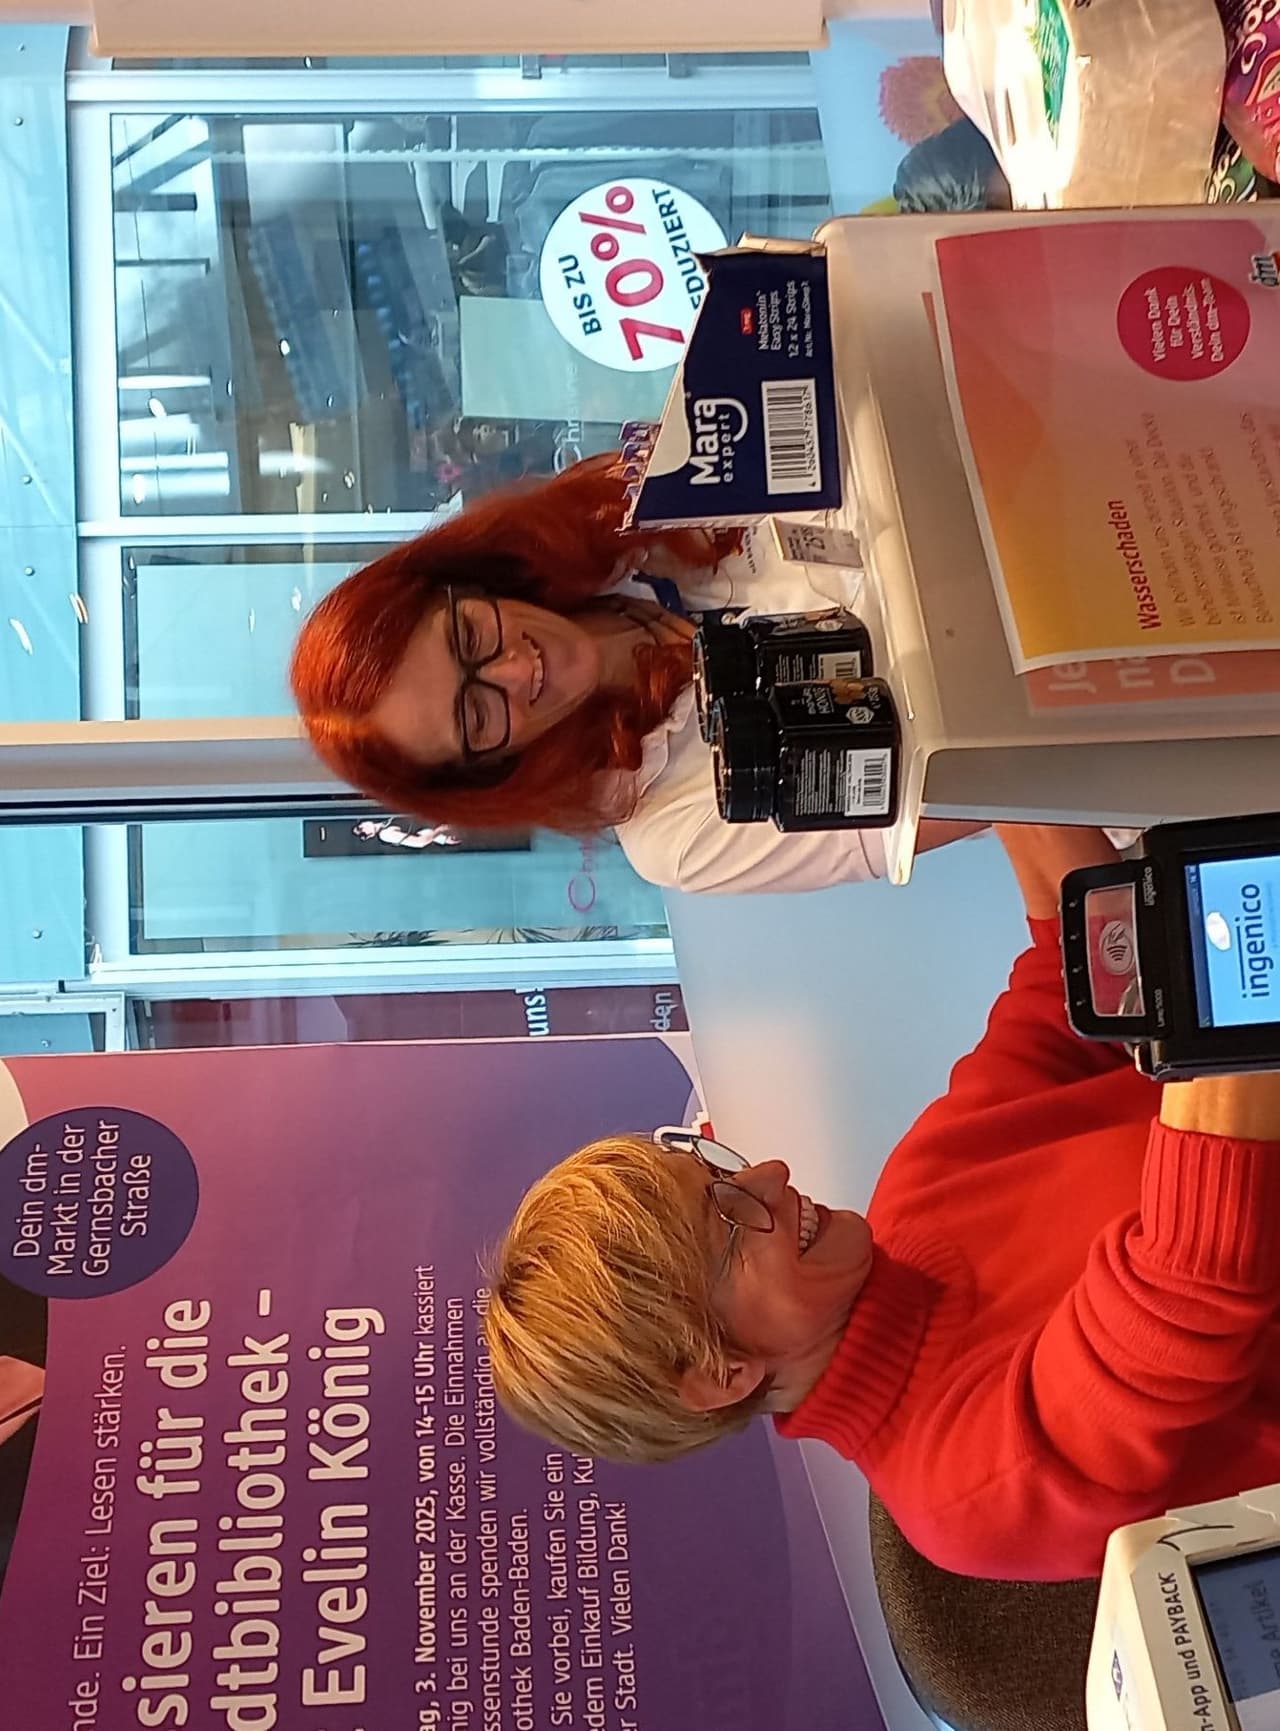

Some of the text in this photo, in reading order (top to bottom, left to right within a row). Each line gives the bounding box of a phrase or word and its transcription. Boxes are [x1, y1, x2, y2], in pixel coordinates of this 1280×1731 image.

[578, 185, 686, 361] 70%
[651, 188, 704, 310] EDUZIERT
[1249, 254, 1280, 287] dm
[558, 254, 602, 336] BIS ZU
[1144, 286, 1166, 362] Vielen Dank
[1164, 295, 1183, 347] für Dein
[1207, 331, 1224, 362] Dein
[689, 398, 748, 485] Mara
[718, 412, 735, 482] expert
[1107, 500, 1162, 630] Wasserschaden
[1234, 883, 1274, 999] ingenico
[12, 1143, 49, 1257] Dein dm-
[46, 1124, 85, 1275] Markt in der
[82, 1119, 120, 1276] Gernsbacher
[120, 1154, 152, 1237] Straße
[414, 1265, 434, 1335] kassiert
[414, 1341, 435, 1376] Uhr
[443, 1297, 465, 1406] Einnahmen
[93, 1345, 126, 1448] stärken.
[444, 1414, 465, 1447] Die
[85, 1458, 117, 1535] Lesen
[419, 1445, 436, 1481] von
[445, 1456, 467, 1520] Kasse.
[475, 1470, 497, 1501] wir
[122, 1299, 211, 1727] sieren für die
[210, 1333, 290, 1731] dtbibliothek
[302, 1307, 385, 1706] Evelin König
[415, 1489, 438, 1543] 2025,
[575, 1492, 601, 1579] Bildung,
[605, 1502, 629, 1561] Dank!
[77, 1546, 111, 1605] Ziel:
[446, 1529, 467, 1564] der
[476, 1509, 503, 1598] spenden
[508, 1508, 532, 1657] Baden-Baden.
[415, 1551, 437, 1663] November
[450, 1573, 467, 1599] an
[543, 1453, 573, 1725] Sie vorbei, kaufen Sie ein
[610, 1569, 634, 1635] Vielen
[1158, 1572, 1192, 1645] PAYBACK
[73, 1616, 105, 1660] Ein
[450, 1607, 468, 1647] uns
[578, 1586, 603, 1668] Einkauf
[415, 1672, 436, 1693] 3.
[446, 1656, 468, 1691] bei
[613, 1643, 638, 1710] Stadt.
[1177, 1649, 1200, 1680] und
